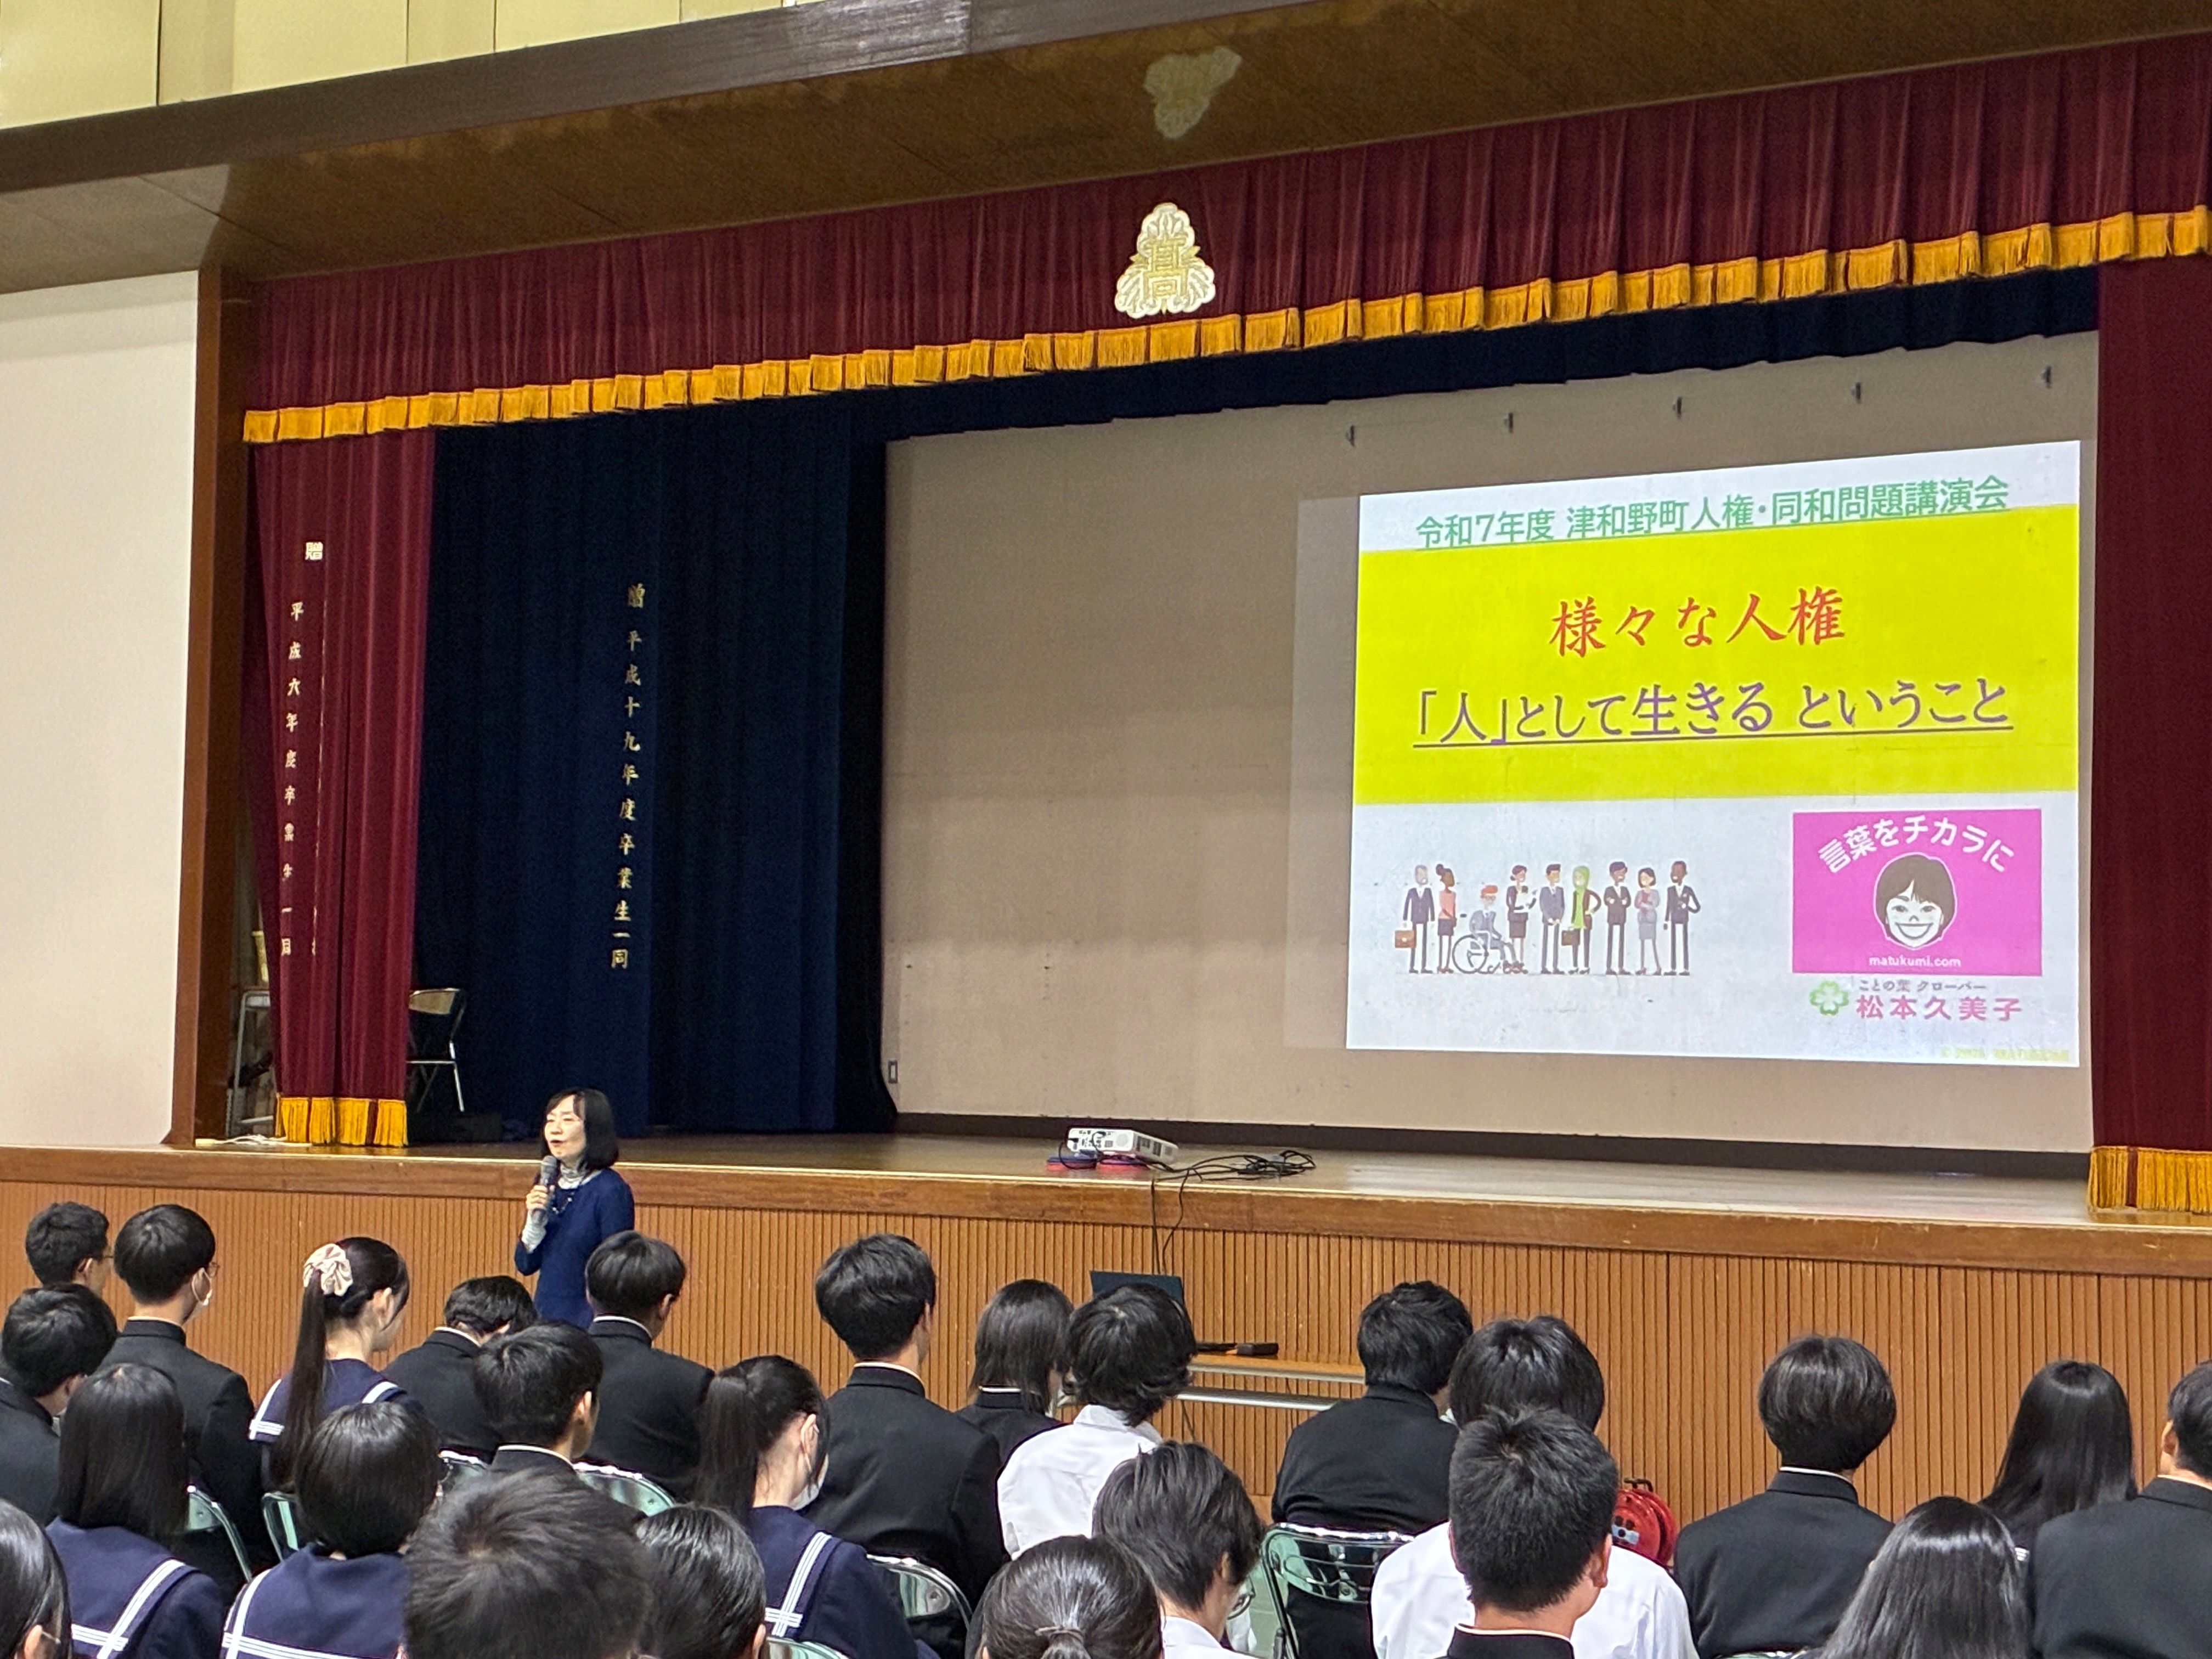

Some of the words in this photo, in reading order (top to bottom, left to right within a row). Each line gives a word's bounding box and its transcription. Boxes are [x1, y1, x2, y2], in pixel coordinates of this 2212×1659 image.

[1416, 508, 1555, 548] 令和7年度
[1566, 474, 2009, 539] 津和野町人権・同和問題講演会
[305, 541, 324, 561] 贈
[1549, 585, 1846, 658] 様々な人権
[1417, 680, 1774, 744] 「人」として生きる
[1799, 677, 2009, 730] ということ
[1818, 815, 2015, 873] 言葉をチカラに
[1869, 955, 1962, 968] matukumi.com
[1859, 979, 1911, 992] ことの葉
[1917, 980, 1987, 992] クローバー
[1855, 994, 2022, 1021] 松本久美子
